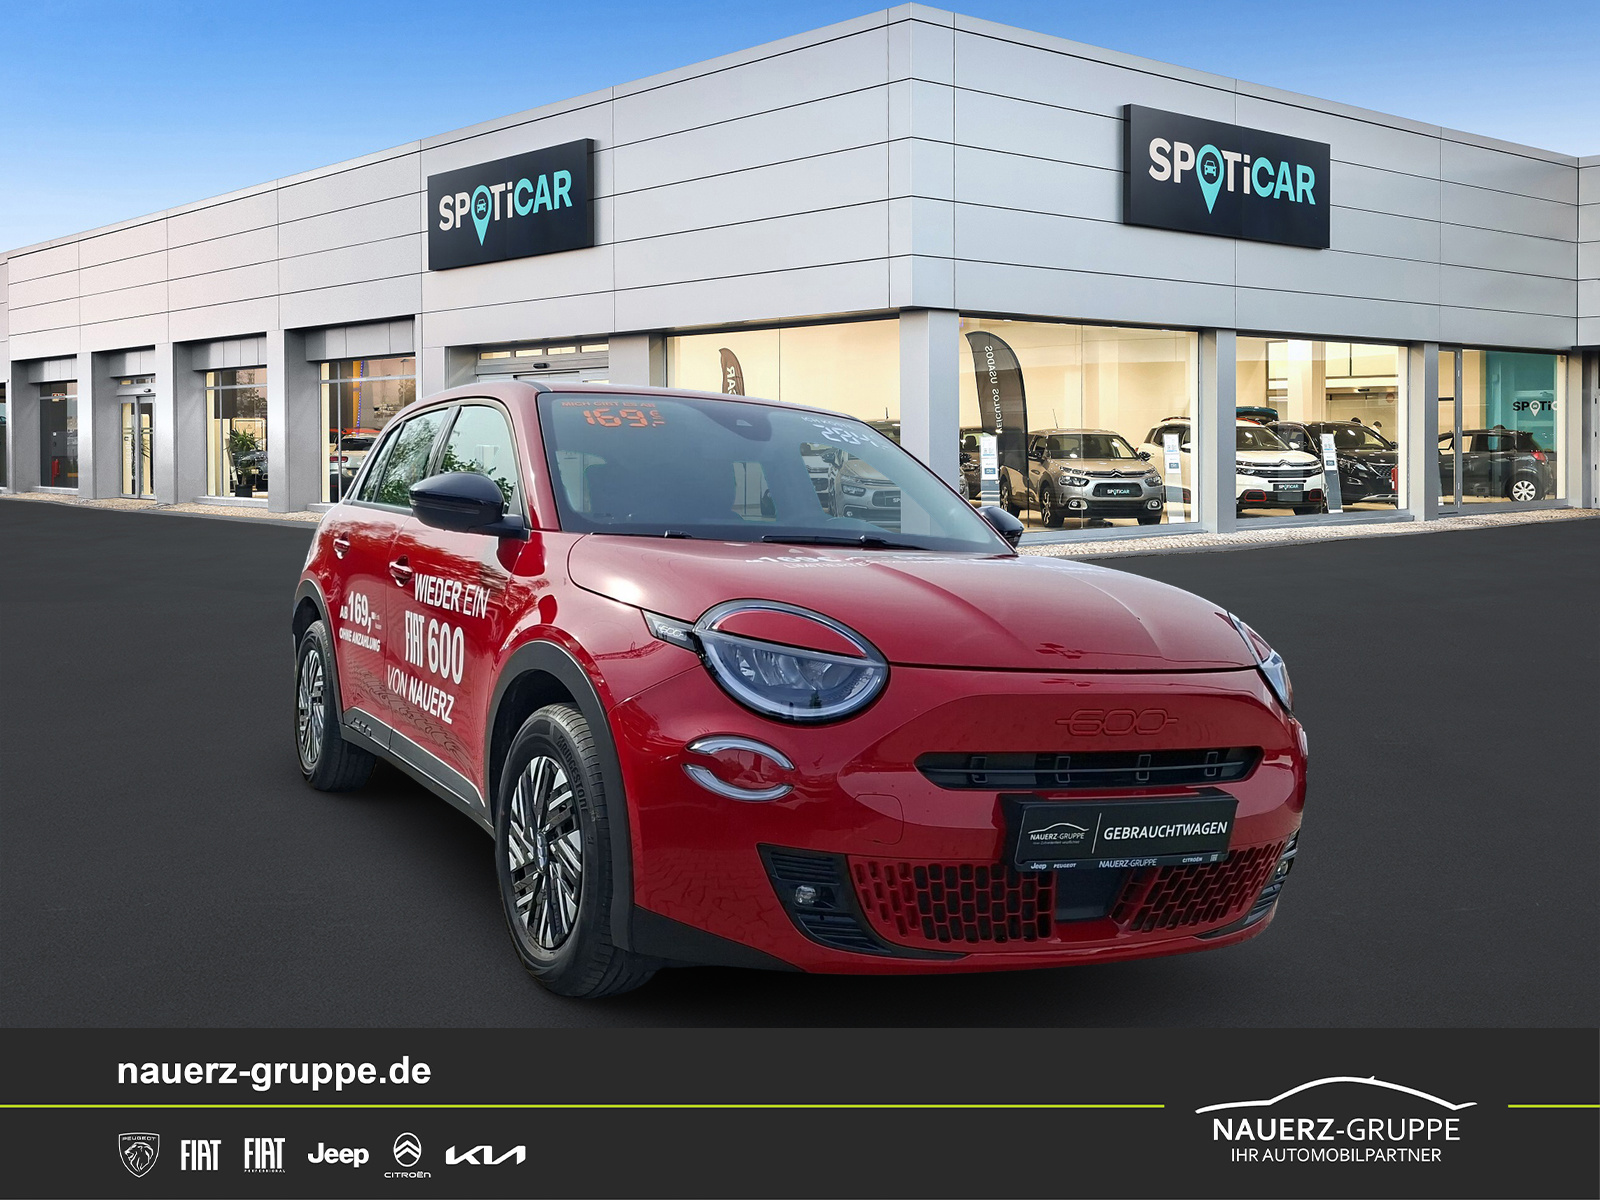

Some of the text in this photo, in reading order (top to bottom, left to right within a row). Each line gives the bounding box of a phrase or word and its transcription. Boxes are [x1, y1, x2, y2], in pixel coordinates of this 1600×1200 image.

[414, 572, 491, 620] WIEDER EIN
[351, 631, 381, 653] ANZAHLUNG
[404, 610, 465, 685] FIAT 600
[387, 664, 455, 725] VON NAUERZ
[1030, 832, 1086, 841] NAUERZ-GRUPPE
[1103, 821, 1229, 841] GEBRAUCHTWAGEN
[1030, 862, 1048, 871] Jeep
[1098, 858, 1158, 869] NAUERZ-GRUPPE
